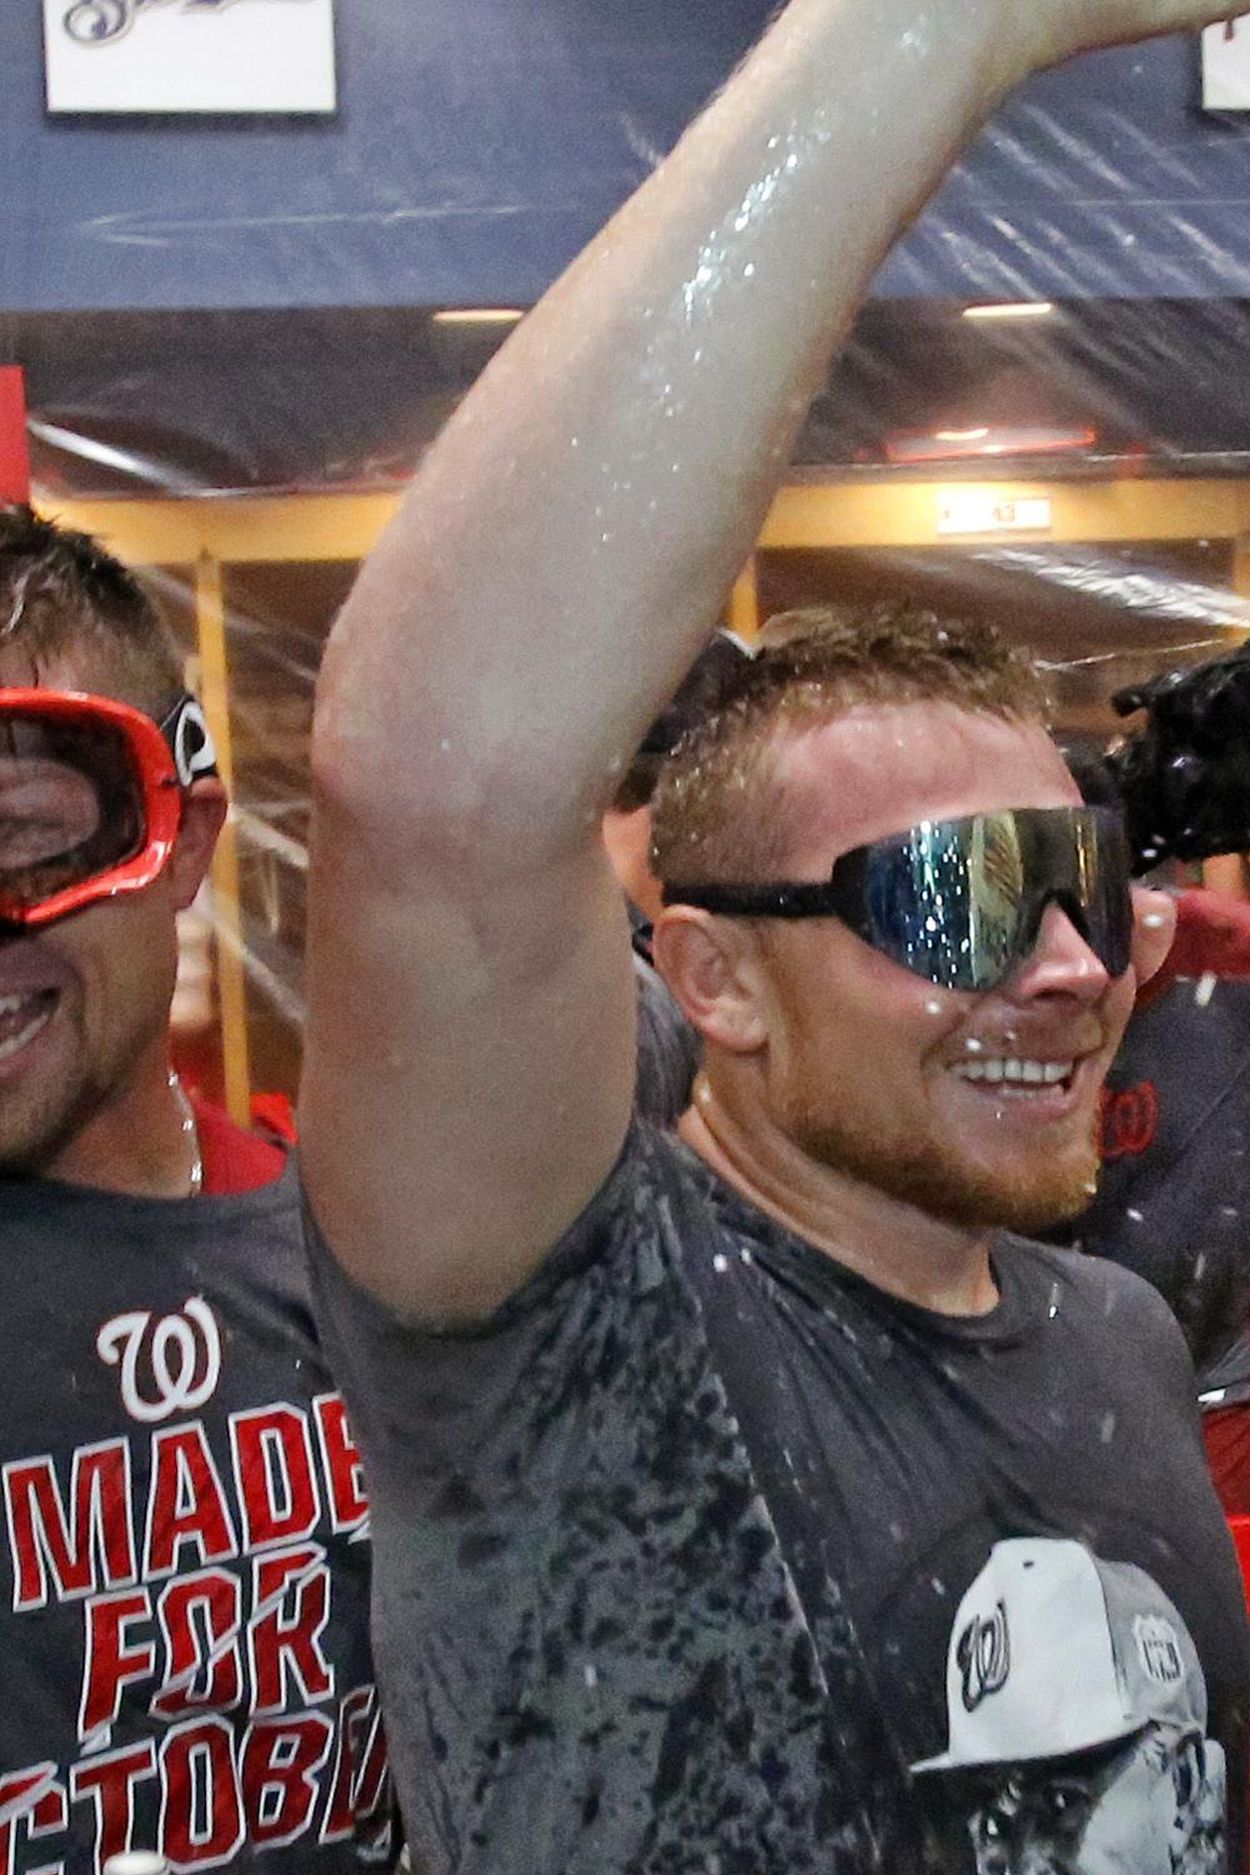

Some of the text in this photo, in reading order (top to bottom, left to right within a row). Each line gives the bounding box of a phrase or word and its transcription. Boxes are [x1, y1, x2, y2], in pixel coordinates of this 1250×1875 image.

[96, 1296, 224, 1423] W
[1, 1390, 373, 1612] MADE
[77, 1540, 335, 1756] FOR
